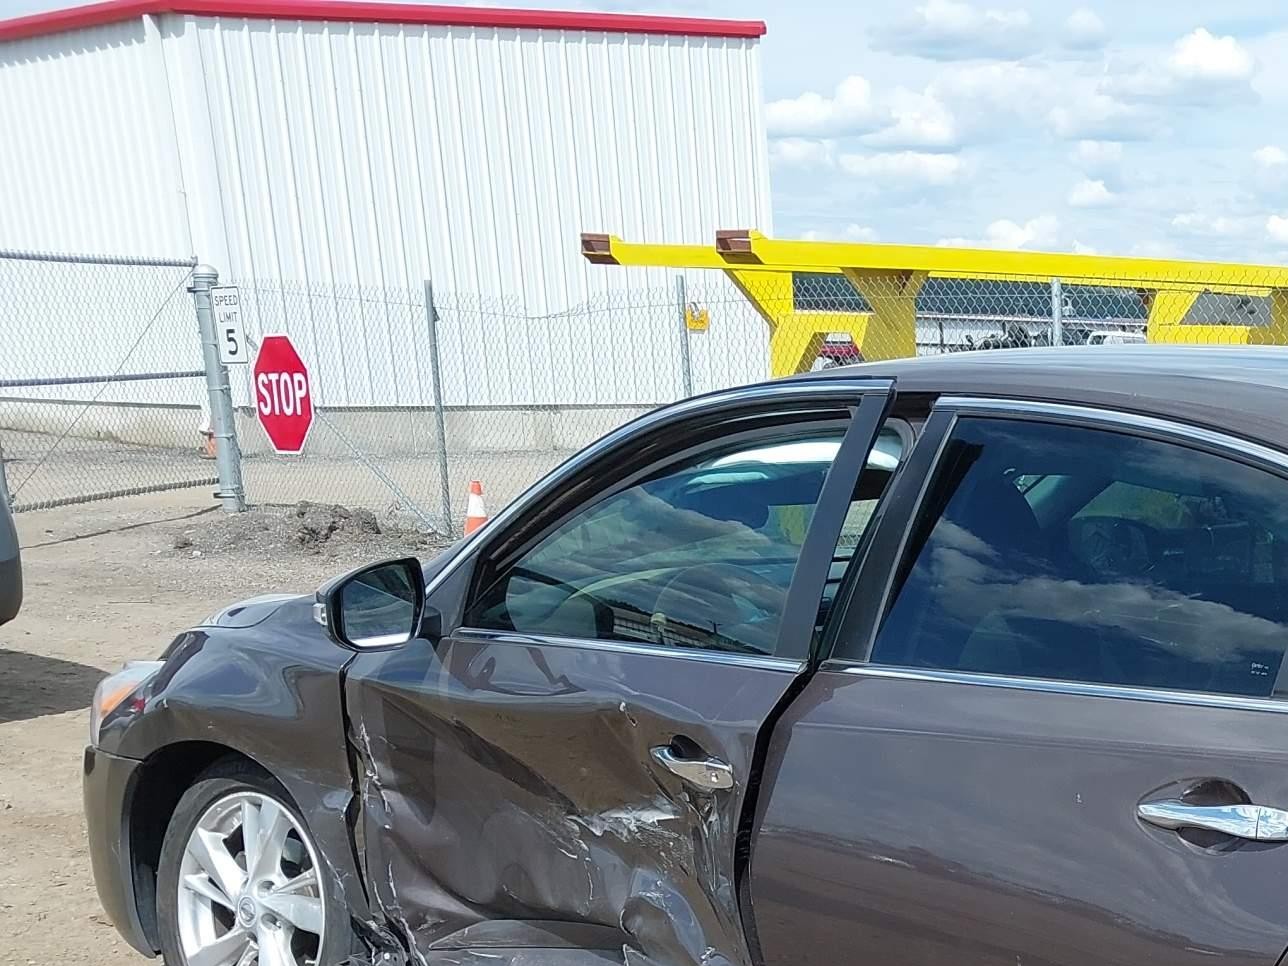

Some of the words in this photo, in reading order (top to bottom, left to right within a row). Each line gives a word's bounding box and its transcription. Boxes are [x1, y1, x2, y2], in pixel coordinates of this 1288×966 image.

[215, 295, 238, 306] SPEED
[219, 312, 238, 323] LIMIT
[226, 329, 238, 356] 5
[257, 372, 307, 416] STOP
